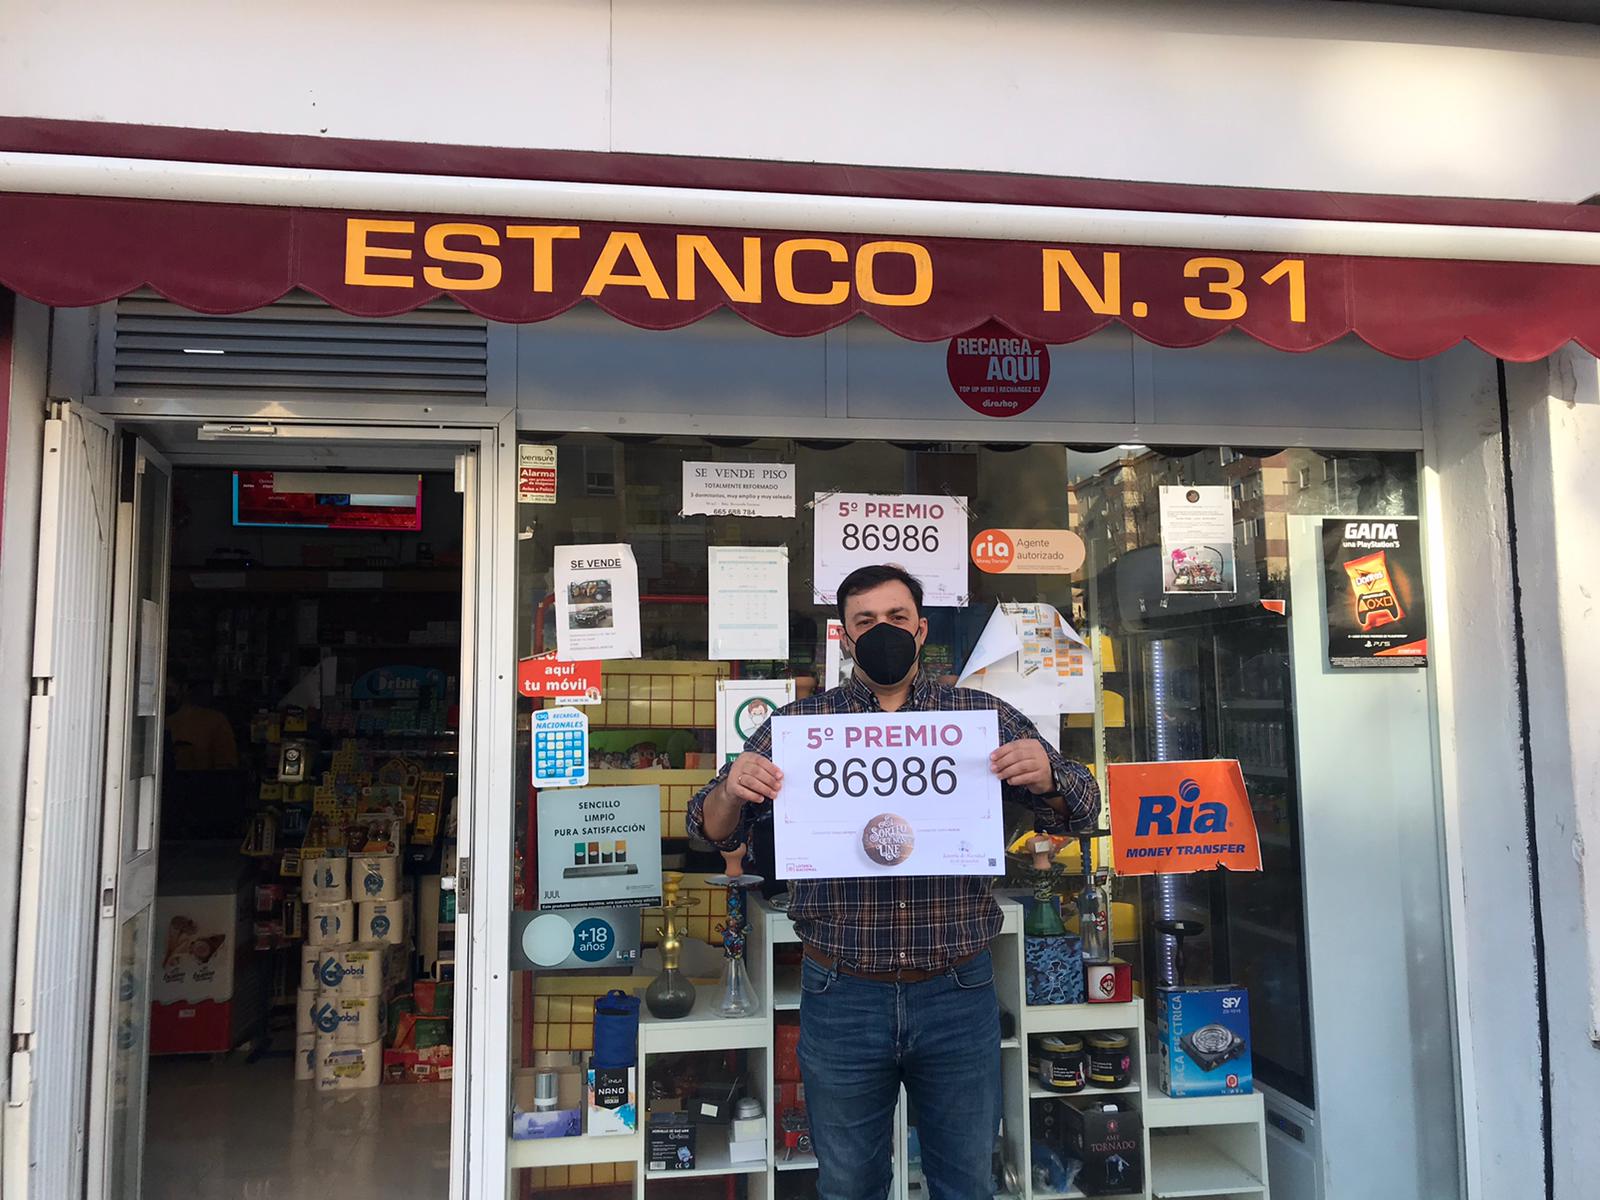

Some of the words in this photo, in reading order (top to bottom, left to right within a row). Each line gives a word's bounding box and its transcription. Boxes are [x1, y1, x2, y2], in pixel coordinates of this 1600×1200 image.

[344, 218, 934, 307] ESTANCO
[1042, 249, 1148, 318] N.
[1183, 257, 1306, 323] 31
[956, 337, 1032, 356] RECARGA
[986, 349, 1042, 383] AQUÍ
[521, 468, 555, 477] Alarma
[695, 467, 708, 478] SE
[715, 468, 756, 479] VENDE
[763, 469, 788, 480] PISO
[704, 482, 742, 490] TOTALMENTE
[864, 502, 945, 520] PREMIO
[841, 522, 940, 553] 86986
[1344, 523, 1399, 540] GANA
[975, 534, 1010, 558] ria
[1016, 538, 1050, 549] Agente
[570, 558, 585, 569] SE
[586, 557, 622, 569] VENDE
[1016, 551, 1065, 561] autorizado
[544, 663, 576, 677] aquí
[524, 679, 541, 691] tu
[545, 677, 588, 691] móvil
[535, 720, 584, 729] NACIONALES
[844, 723, 963, 748] PREMIO
[812, 755, 958, 799] 86986
[578, 800, 621, 810] SENCILLO
[1134, 778, 1229, 837] Ria
[584, 813, 616, 823] LIMPIO
[554, 828, 579, 837] PURA
[582, 824, 646, 836] SATISFACCIÓN
[1126, 846, 1174, 858] MONEY
[1176, 844, 1246, 855] TRANSFER
[578, 926, 608, 943] +18
[579, 941, 606, 951] años
[1222, 996, 1241, 1009] SFY
[1174, 1055, 1186, 1096] PCA
[598, 1086, 625, 1096] NANO
[1090, 1140, 1136, 1153] TORNADO
